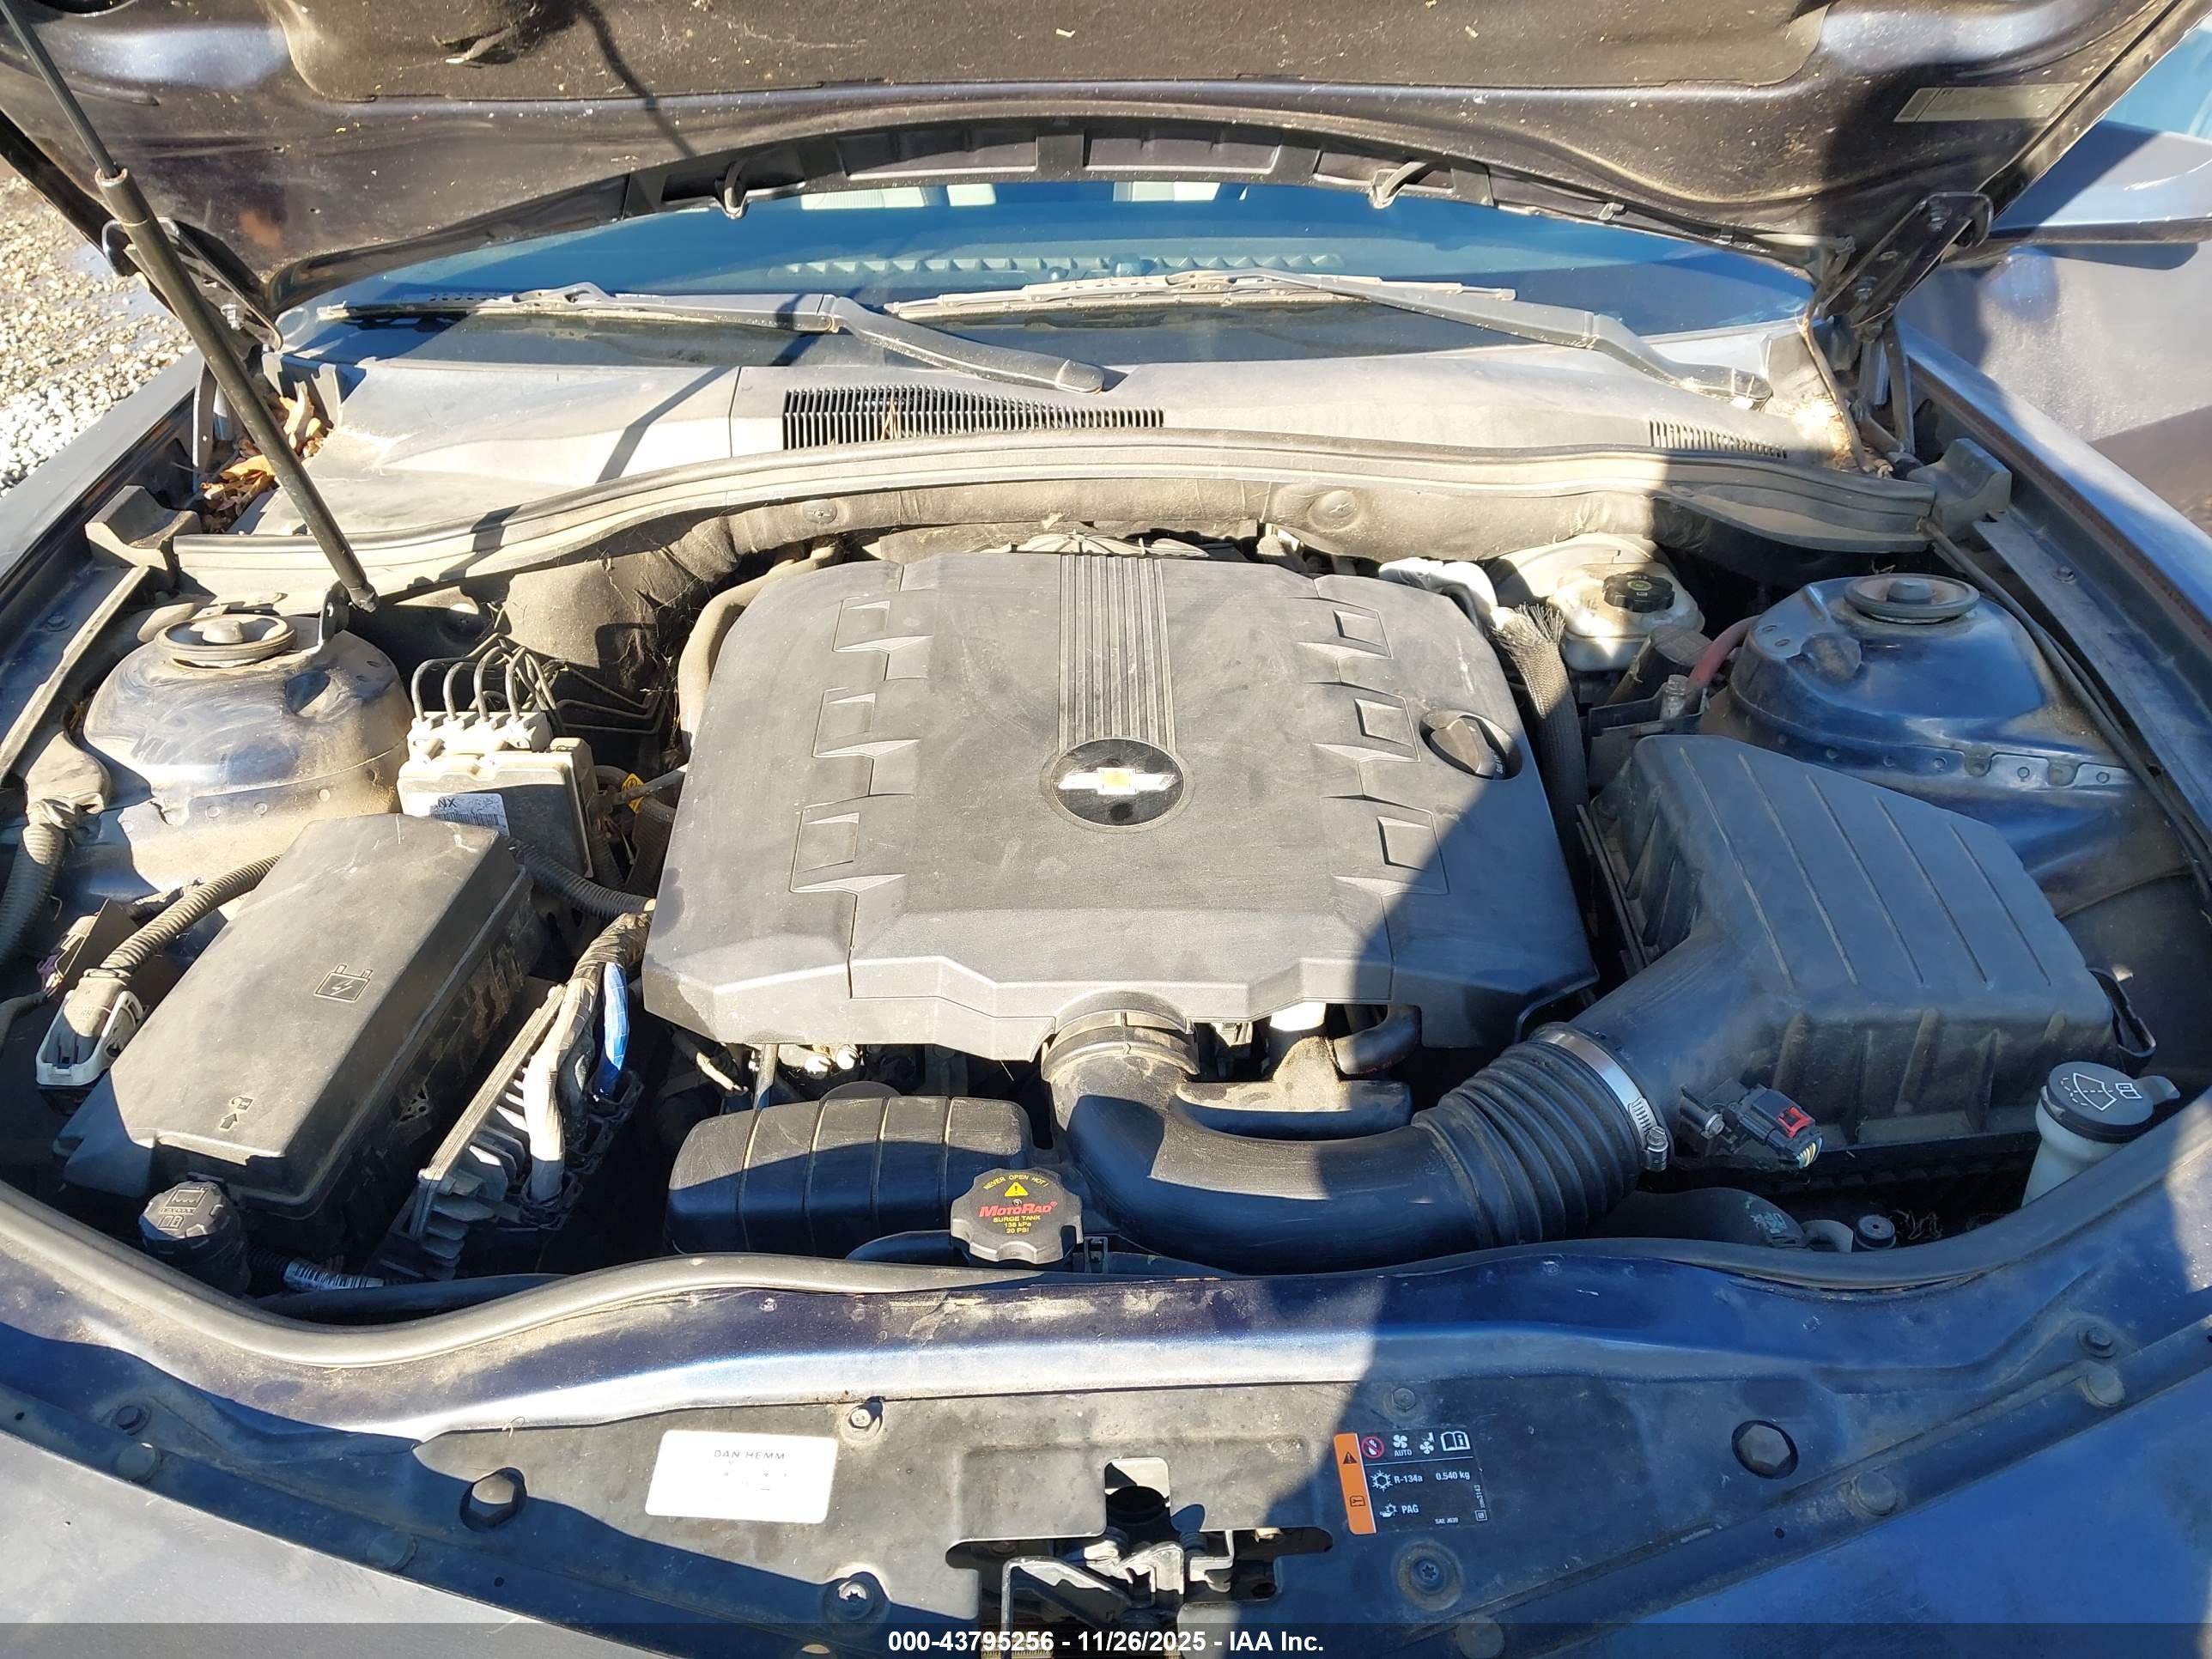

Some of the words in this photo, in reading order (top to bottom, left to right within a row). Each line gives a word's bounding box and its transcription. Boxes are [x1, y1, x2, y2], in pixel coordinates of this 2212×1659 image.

[983, 1176, 1006, 1190] NEVER
[714, 1449, 740, 1458] DAN
[1394, 1449, 1413, 1457] AUTO
[1393, 1474, 1424, 1484] R-134a
[1435, 1471, 1458, 1481] 0.540
[1458, 1470, 1471, 1481] kg
[1401, 1504, 1419, 1515] PAG
